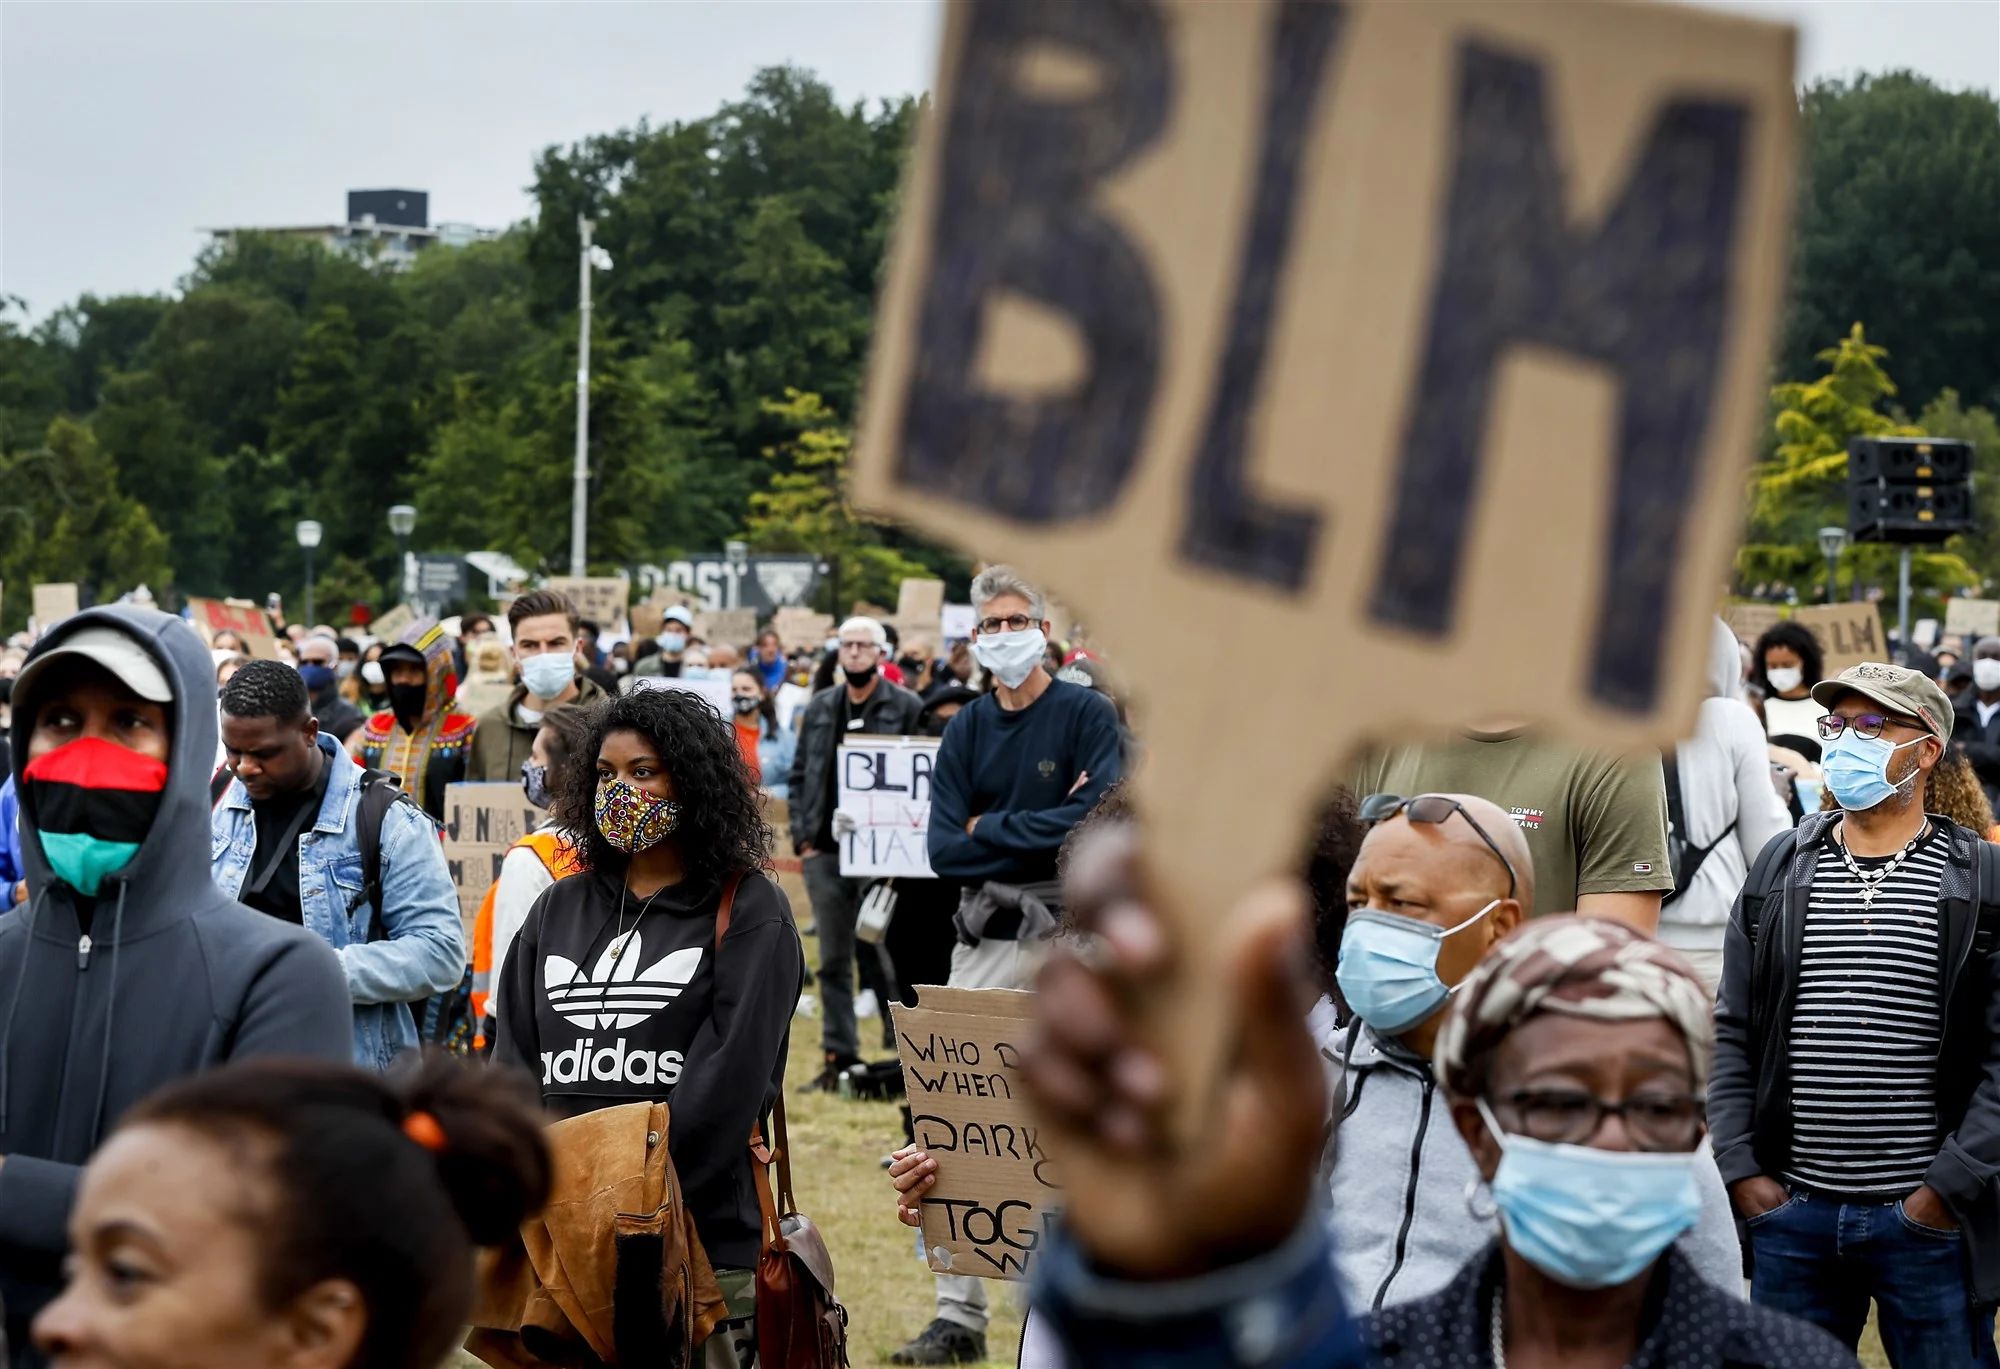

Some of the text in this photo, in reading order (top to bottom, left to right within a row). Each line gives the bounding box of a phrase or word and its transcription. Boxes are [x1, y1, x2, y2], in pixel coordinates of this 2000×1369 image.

[890, 0, 1757, 716] BLM
[1511, 807, 1544, 816] TOMMY
[1515, 820, 1539, 830] EANS
[901, 1032, 980, 1066] WHO
